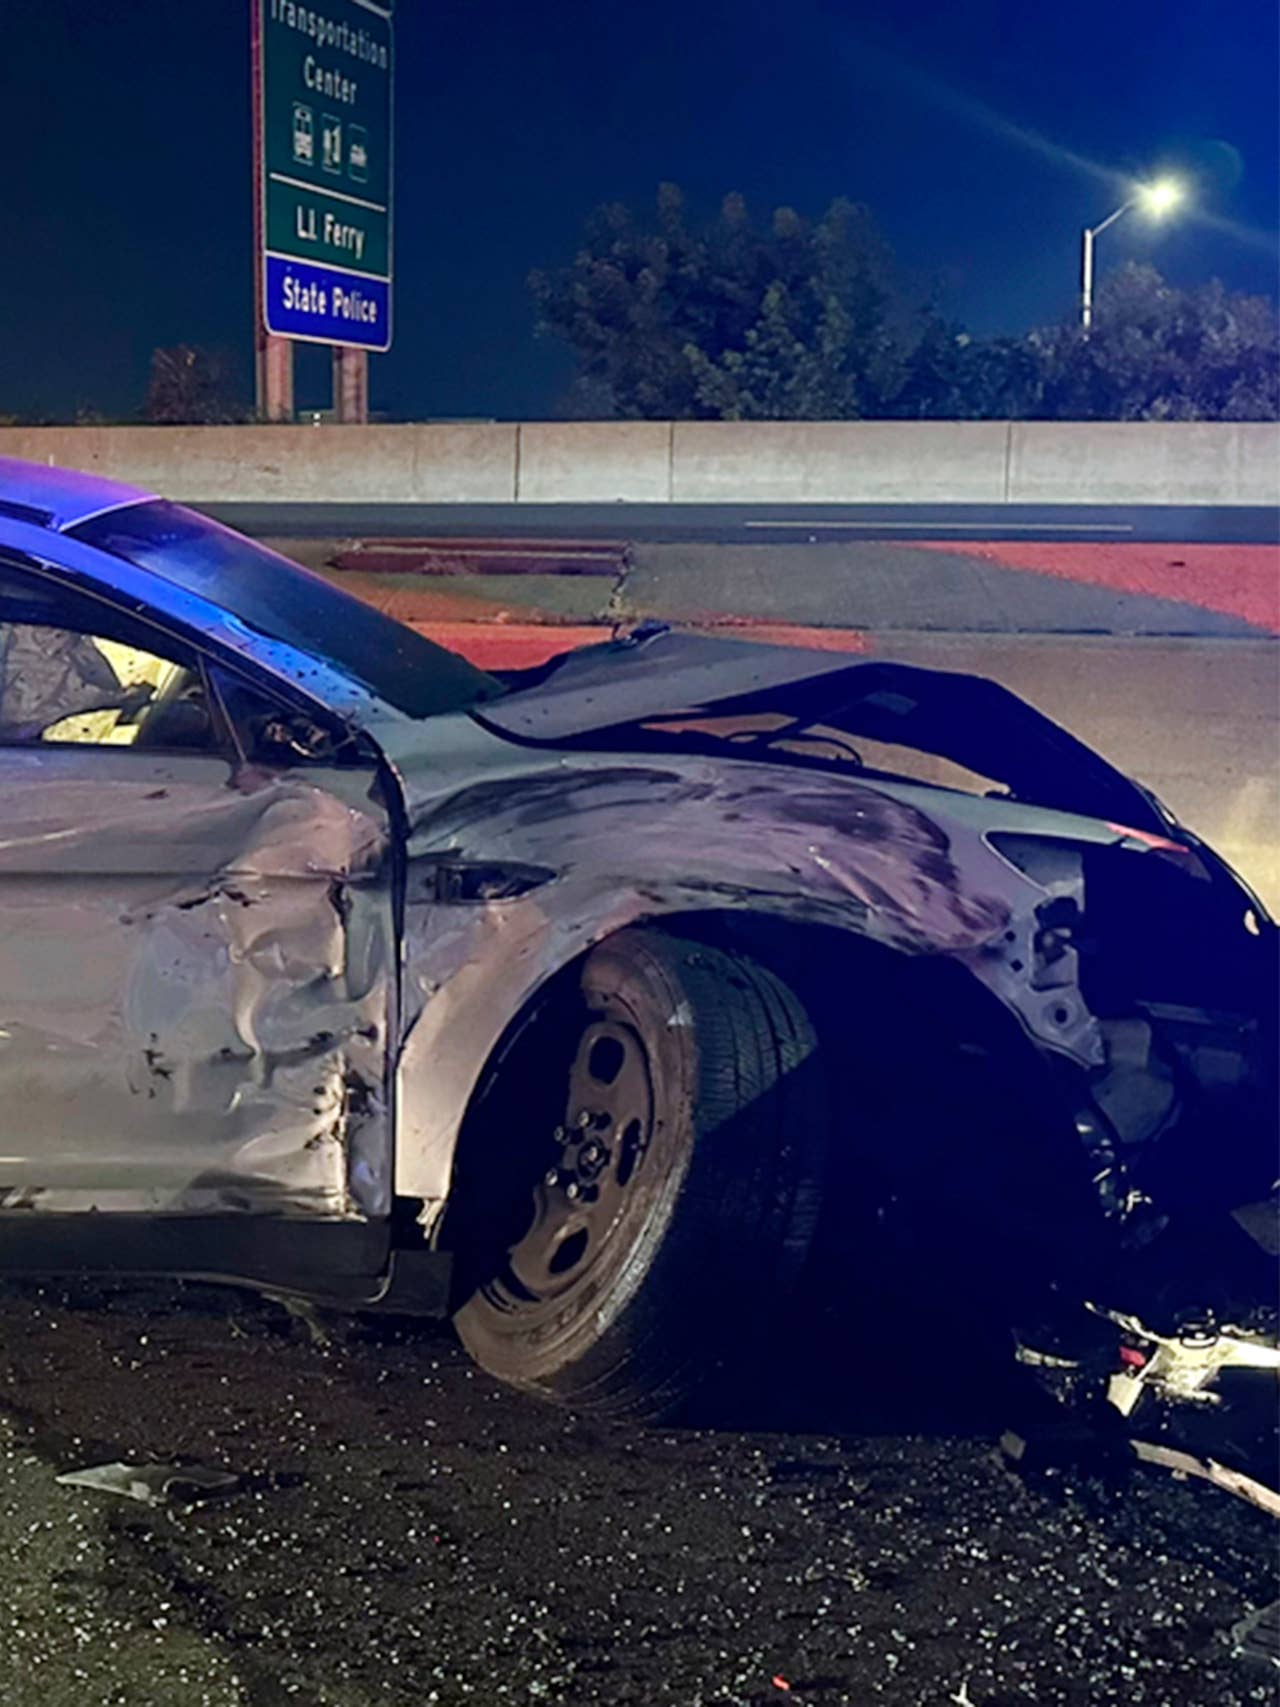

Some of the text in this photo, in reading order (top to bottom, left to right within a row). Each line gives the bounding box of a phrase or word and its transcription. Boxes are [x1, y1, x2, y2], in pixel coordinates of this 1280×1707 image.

[304, 55, 357, 104] Center
[324, 213, 365, 260] Ferry
[282, 276, 377, 324] State Police
